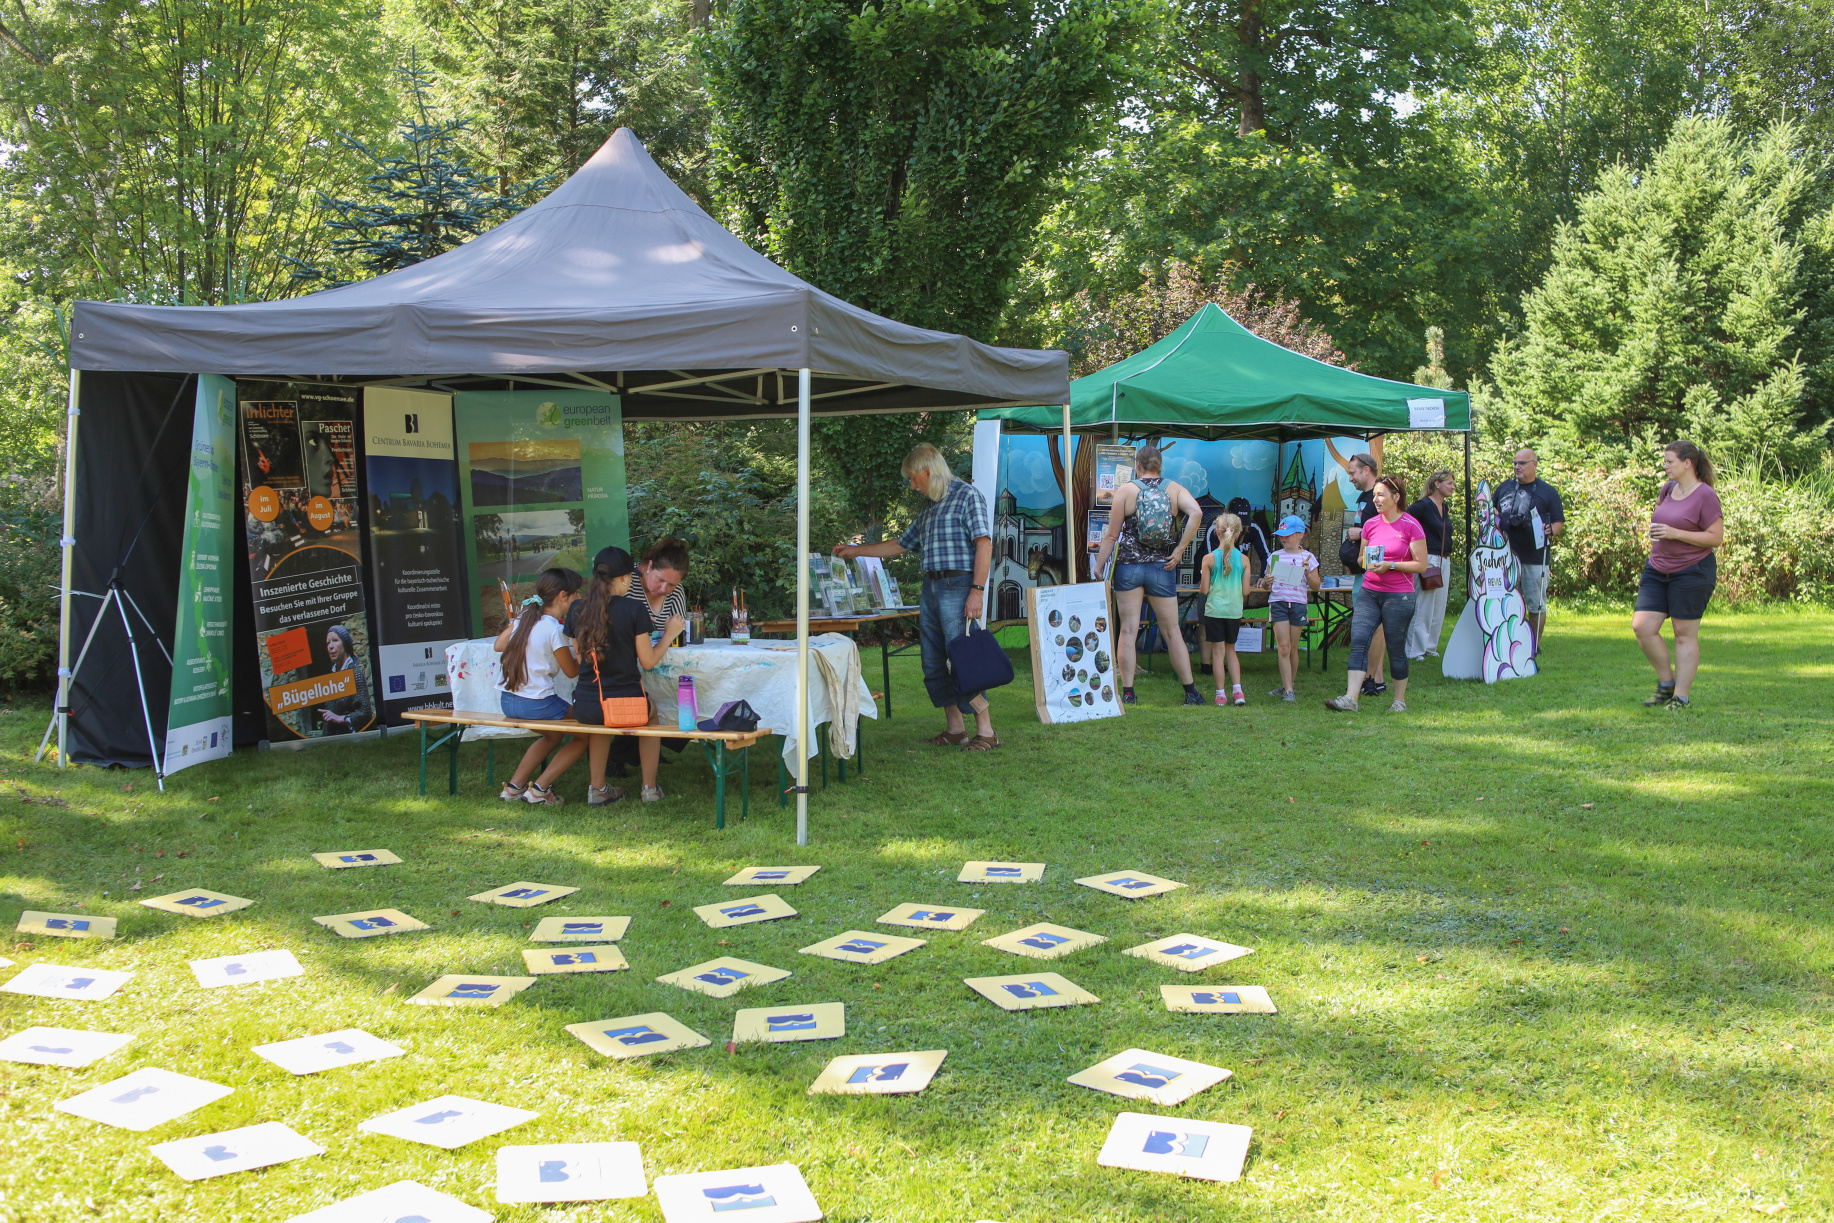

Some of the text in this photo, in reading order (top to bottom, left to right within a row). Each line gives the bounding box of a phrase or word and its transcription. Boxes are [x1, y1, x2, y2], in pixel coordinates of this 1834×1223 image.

[301, 394, 354, 403] www.vg-schoensee.de
[246, 403, 294, 419] Irrlichter
[563, 405, 611, 416] european
[319, 423, 351, 433] Pascher
[564, 416, 612, 429] greenbelt
[372, 436, 451, 449] CENTRUM BAVARIA BOHEMIA
[260, 505, 272, 513] Juli
[310, 512, 331, 520] August
[260, 574, 352, 597] Inszenierte Geschichte
[260, 590, 358, 614] Besuchen Sie mit Ihrer Gruppe
[279, 603, 346, 624] das verlassene Dorf
[277, 676, 350, 710] „Bügellohe“
